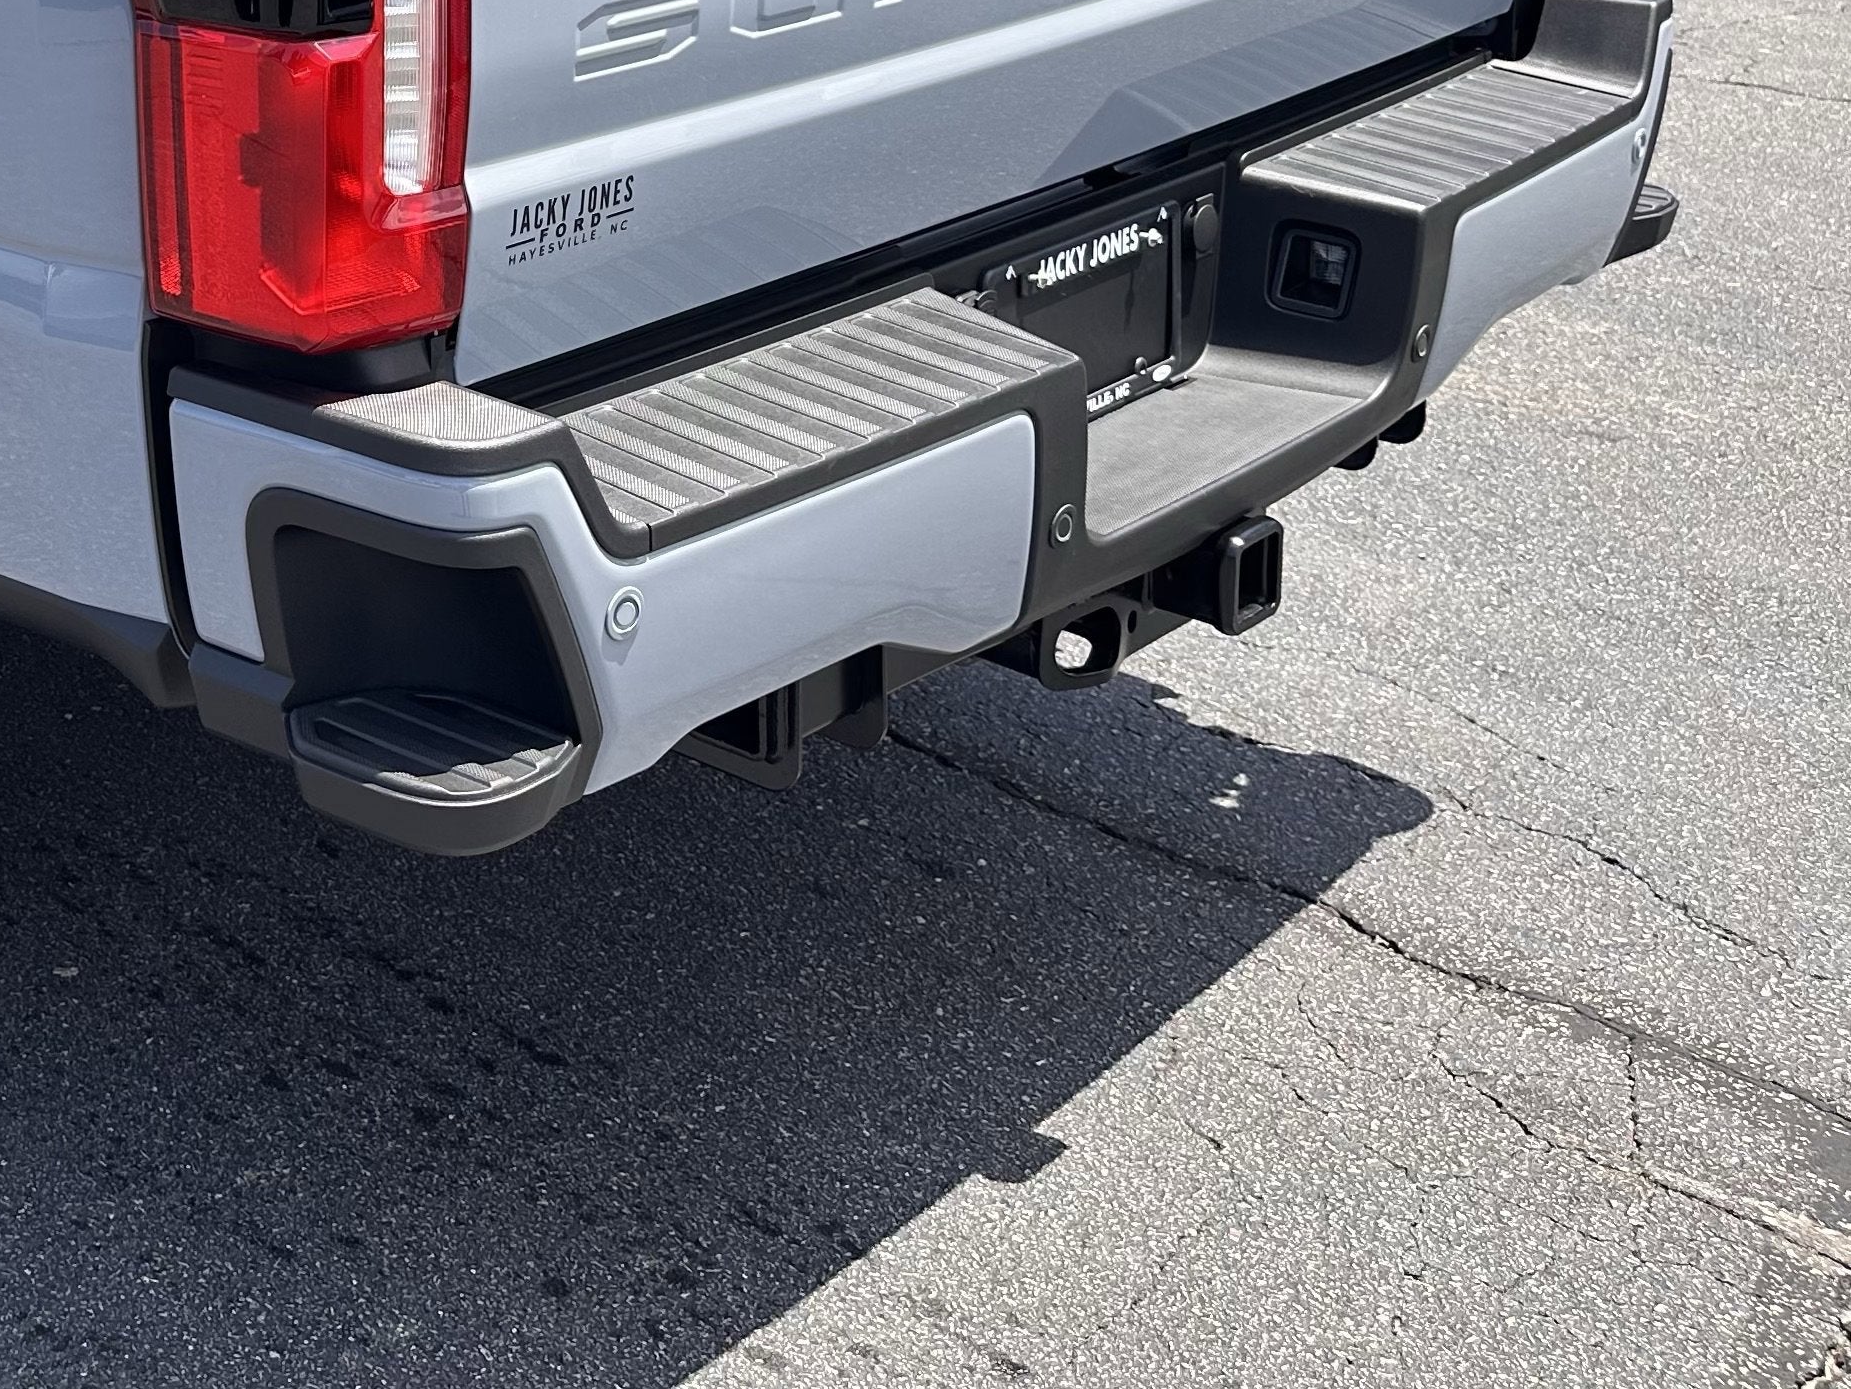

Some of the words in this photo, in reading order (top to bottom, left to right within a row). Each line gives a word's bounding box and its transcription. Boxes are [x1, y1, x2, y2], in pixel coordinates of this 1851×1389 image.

[510, 192, 571, 237] JACKY
[577, 174, 635, 217] JONES
[539, 212, 602, 244] FORD
[609, 219, 629, 235] NC
[1037, 242, 1088, 286] JACKY
[1089, 223, 1139, 268] JONES
[1115, 382, 1131, 400] NC
